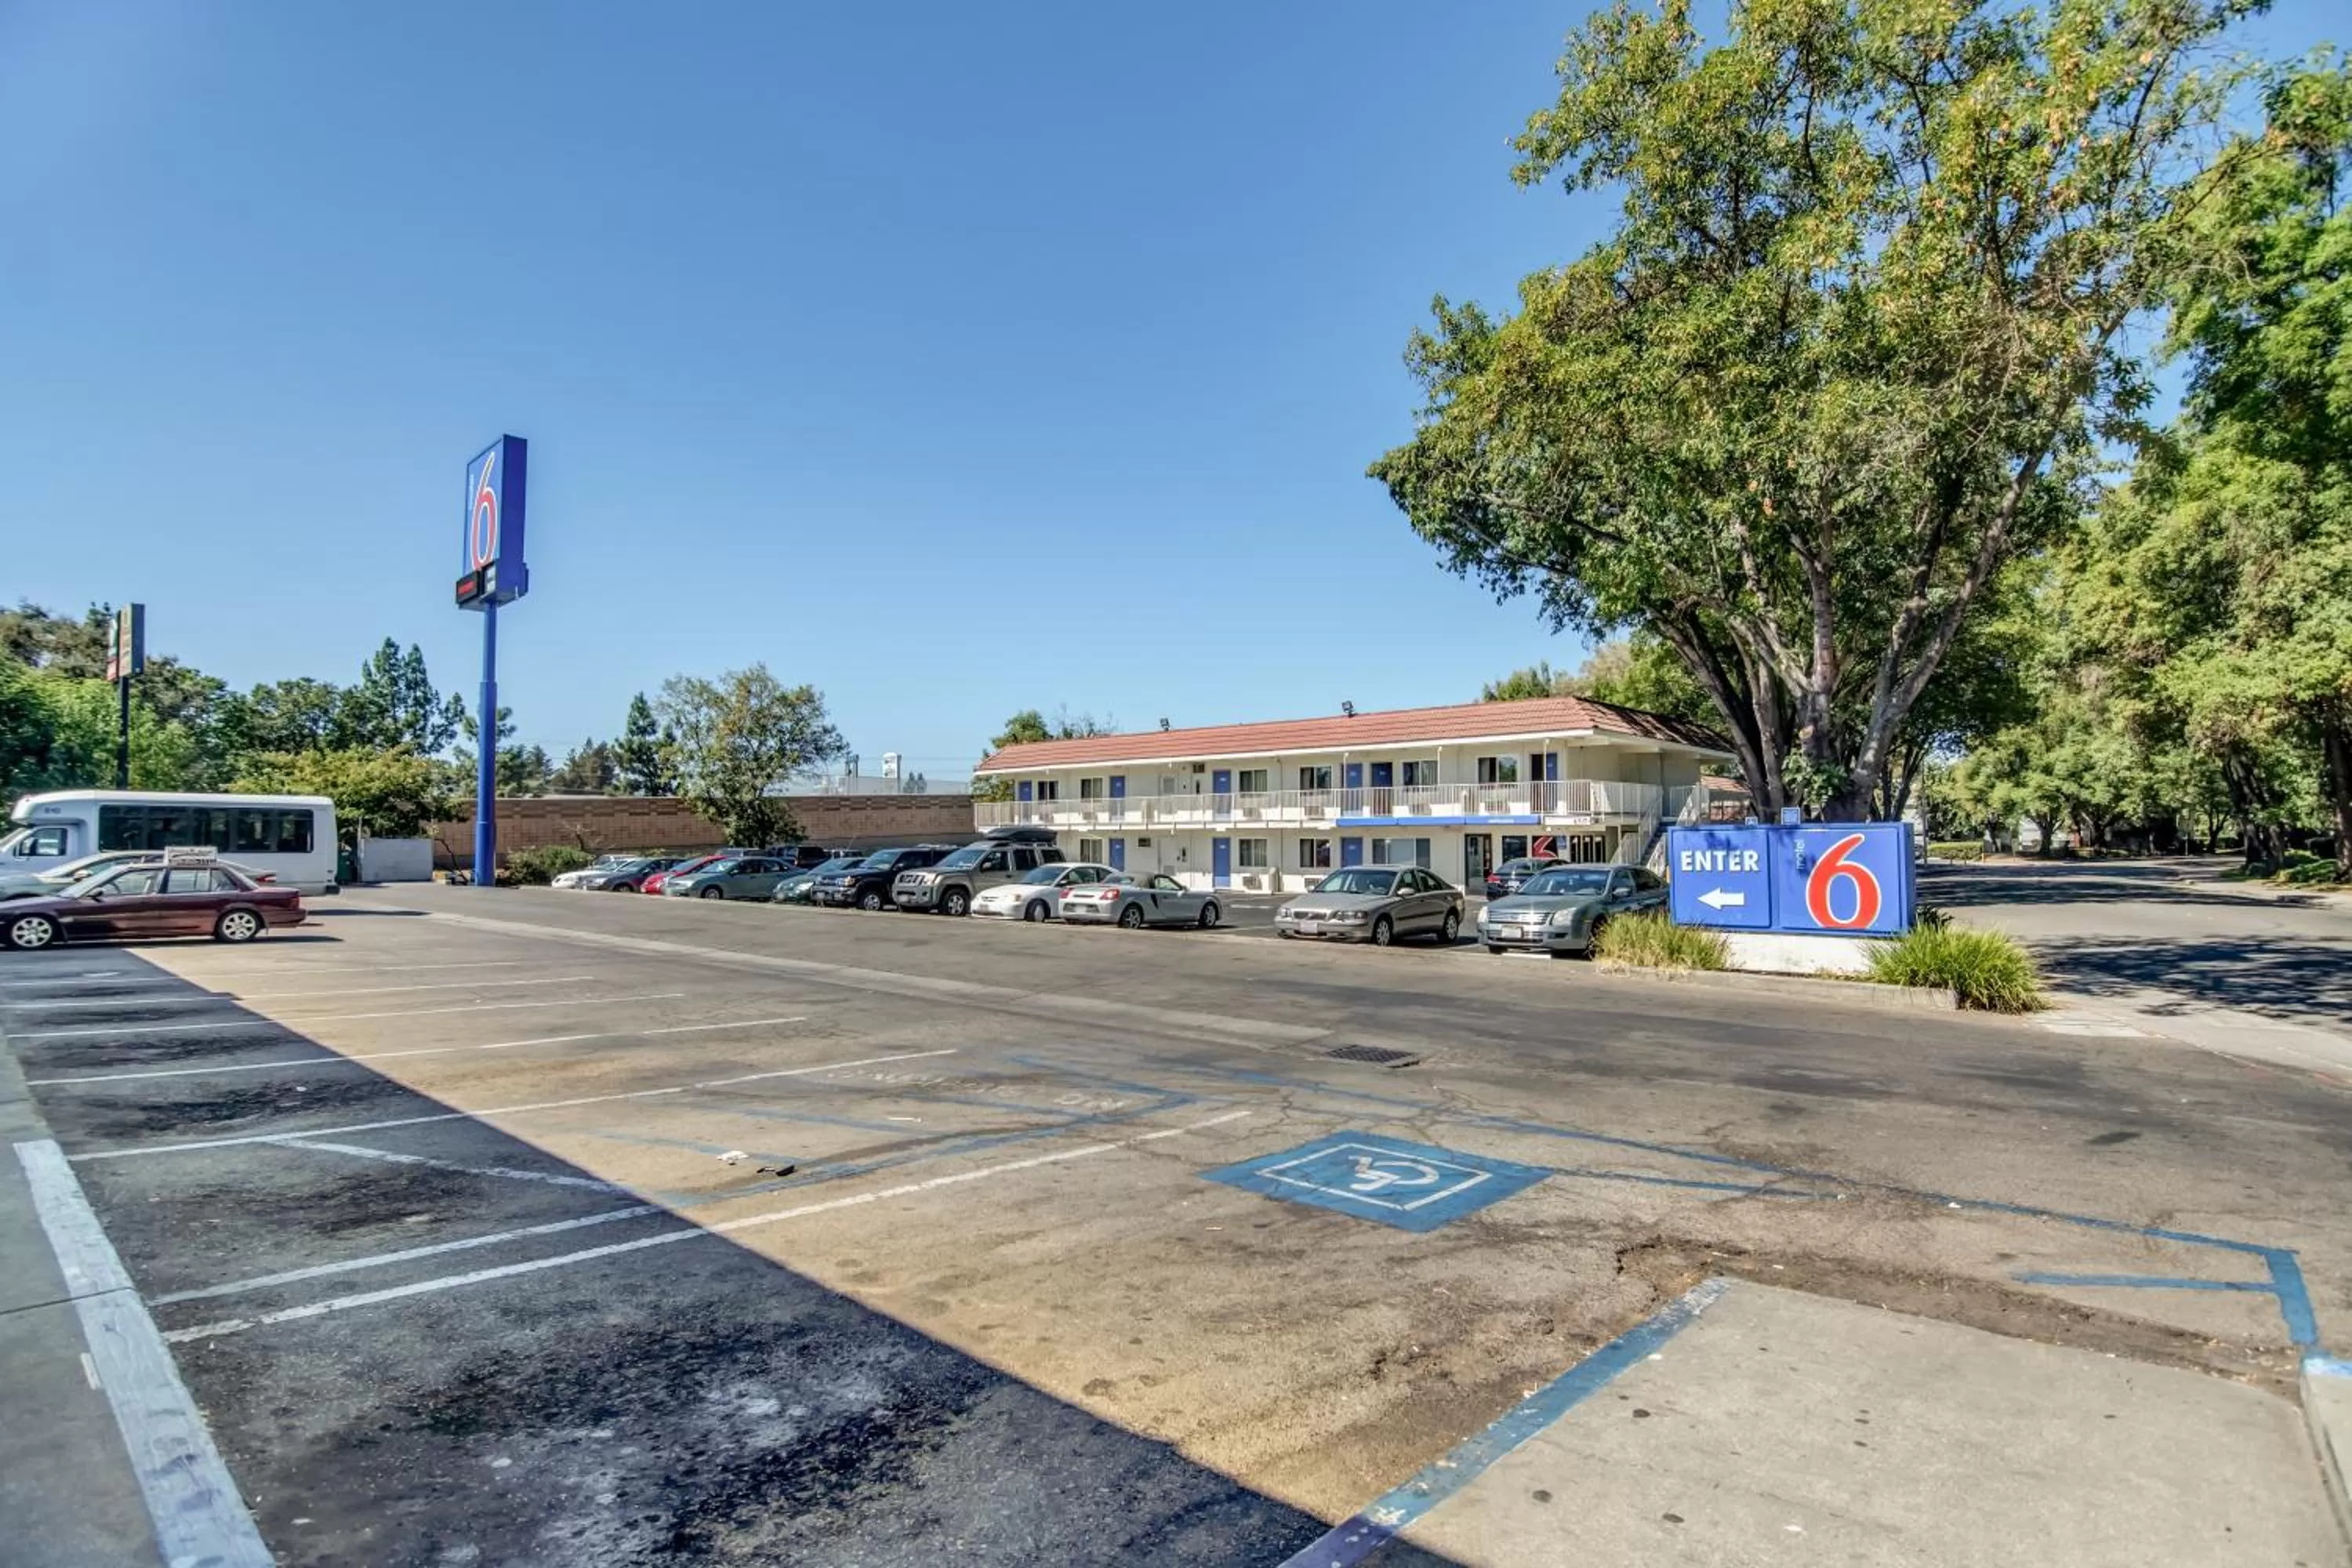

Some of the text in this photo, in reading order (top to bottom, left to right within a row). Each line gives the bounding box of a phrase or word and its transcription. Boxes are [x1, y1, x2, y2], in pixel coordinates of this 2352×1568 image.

[470, 450, 498, 572] 6
[1680, 849, 1759, 872] ENTER
[1806, 833, 1882, 929] 6
